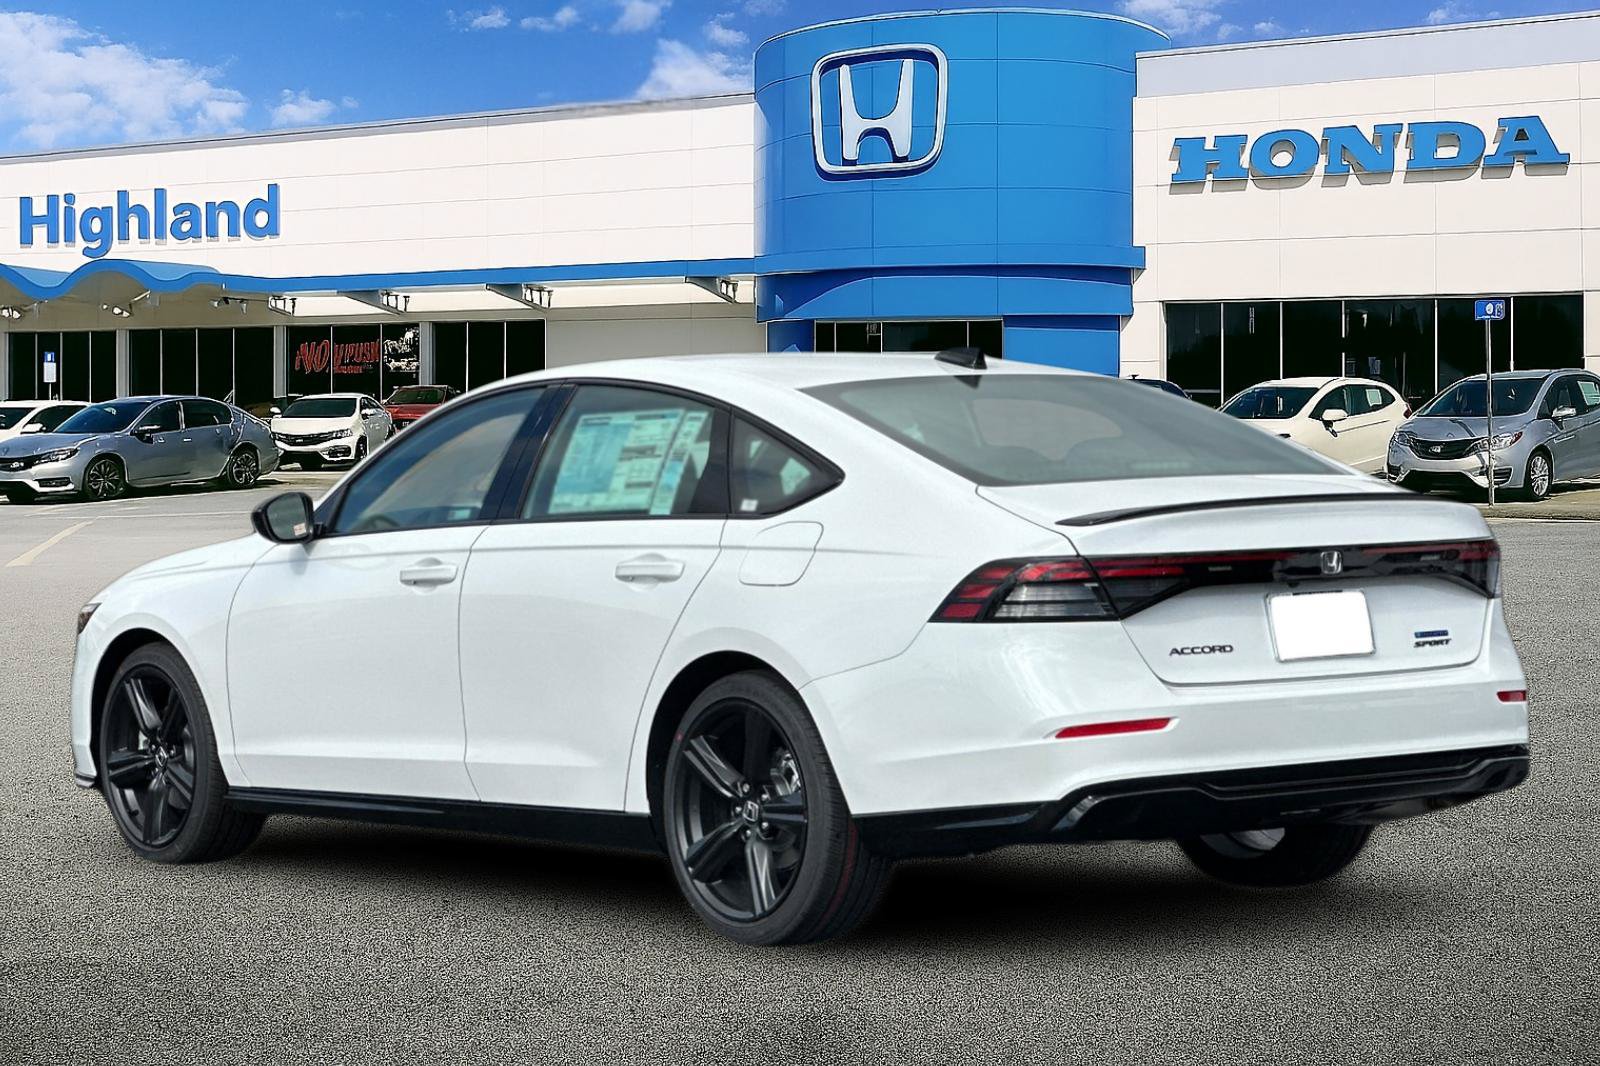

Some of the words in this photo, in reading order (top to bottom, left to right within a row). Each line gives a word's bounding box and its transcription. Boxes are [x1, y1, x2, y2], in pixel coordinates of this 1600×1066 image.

[1171, 115, 1571, 182] HONDA
[19, 183, 281, 259] Highland
[1168, 644, 1234, 657] ACCORD
[1413, 637, 1453, 649] SPORT
